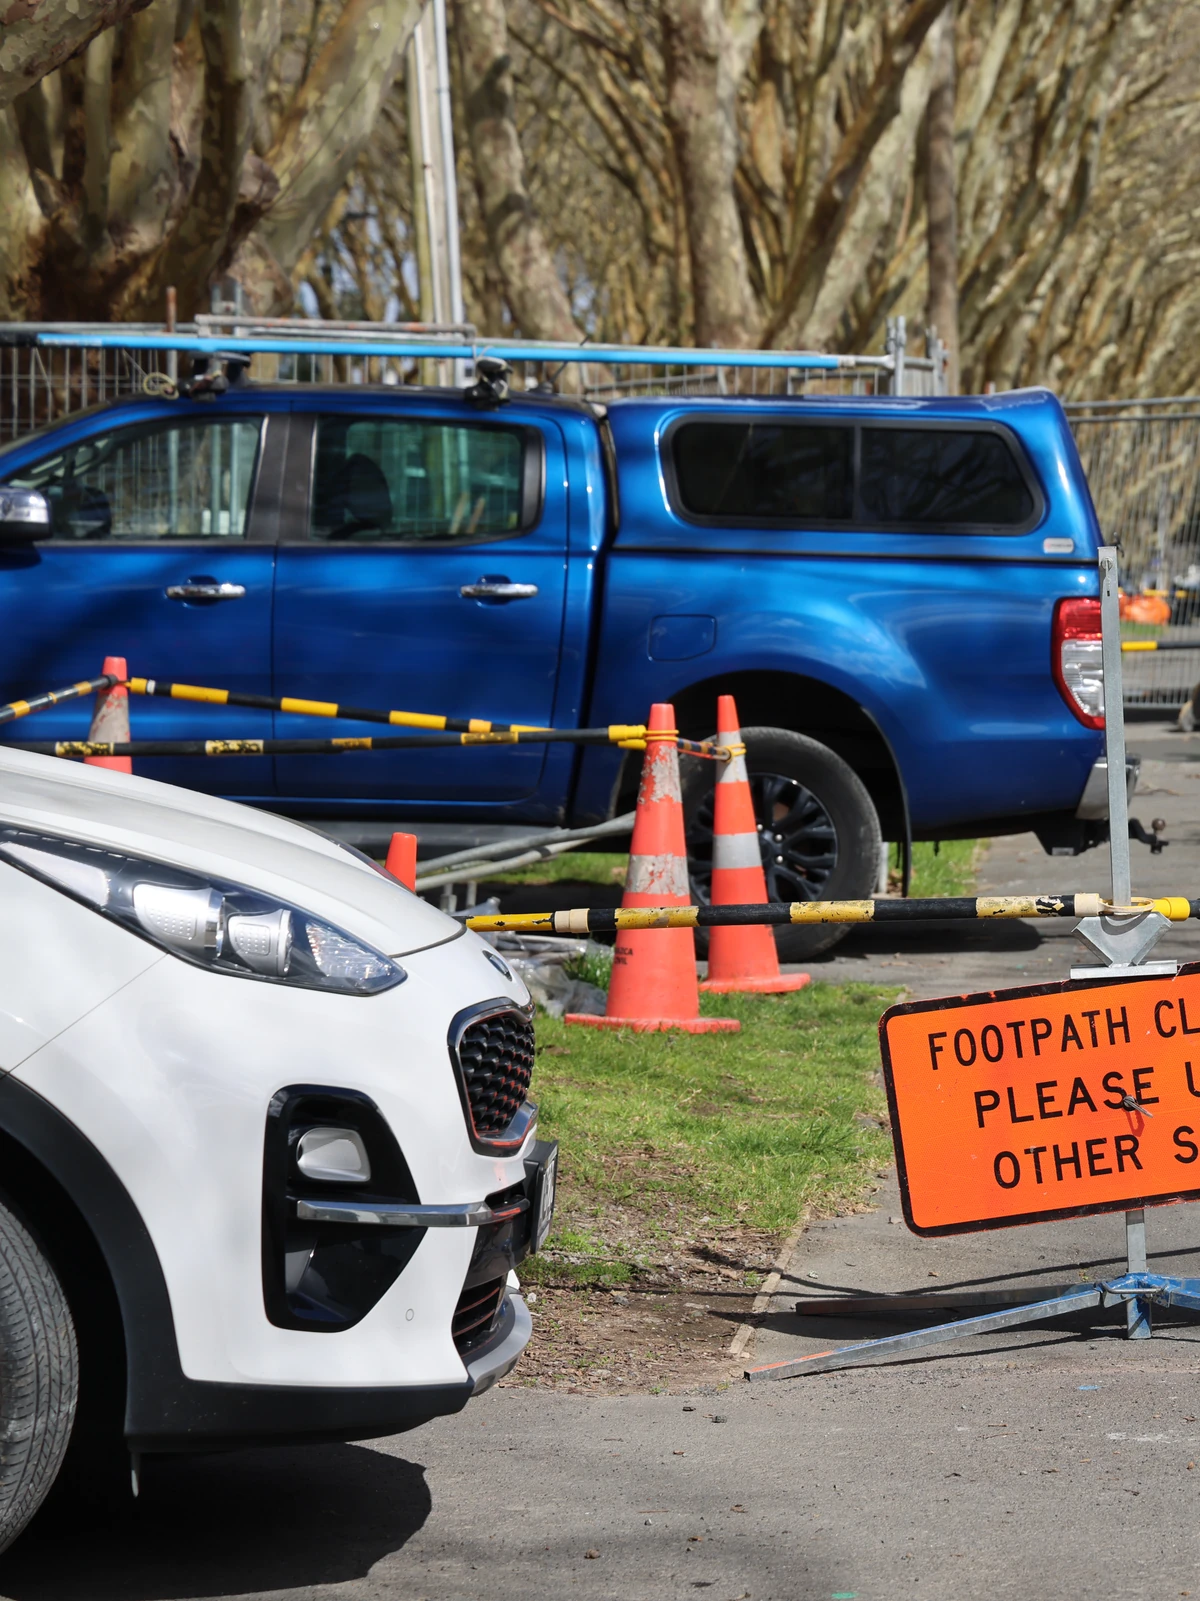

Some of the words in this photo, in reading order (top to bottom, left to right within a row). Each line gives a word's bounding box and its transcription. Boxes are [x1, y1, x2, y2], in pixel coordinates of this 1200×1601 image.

[928, 1006, 1130, 1071] FOOTPATH
[974, 1066, 1160, 1129] PLEASE
[993, 1134, 1143, 1189] OTHER
